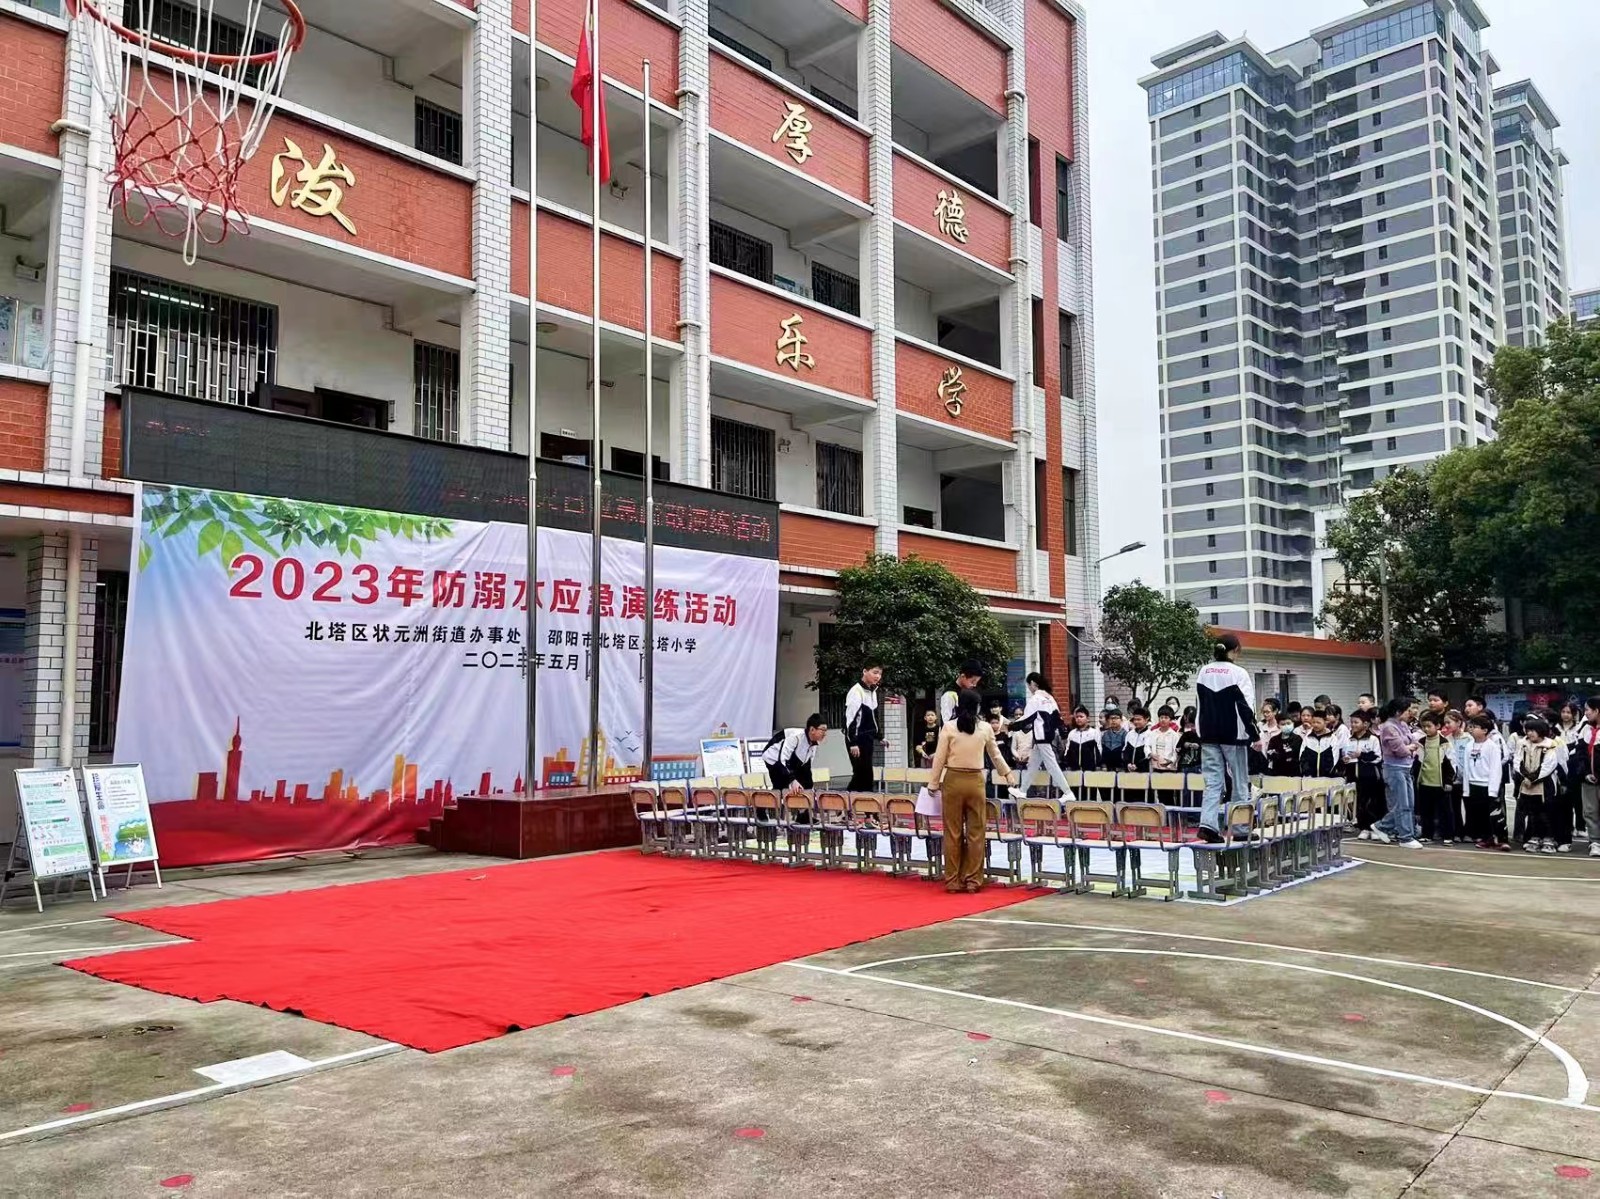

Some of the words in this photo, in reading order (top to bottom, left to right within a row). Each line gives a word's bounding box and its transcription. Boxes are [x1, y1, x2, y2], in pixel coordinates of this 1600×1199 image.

[771, 101, 813, 164] 厚
[934, 190, 969, 244] 德
[776, 313, 816, 371] 乐
[937, 366, 968, 418] 学
[229, 554, 737, 627] 2023年防溺水应急演练活动
[304, 621, 521, 644] 北塔区状元洲街道办事处
[547, 629, 697, 654] 邵阳市北塔区塔小学
